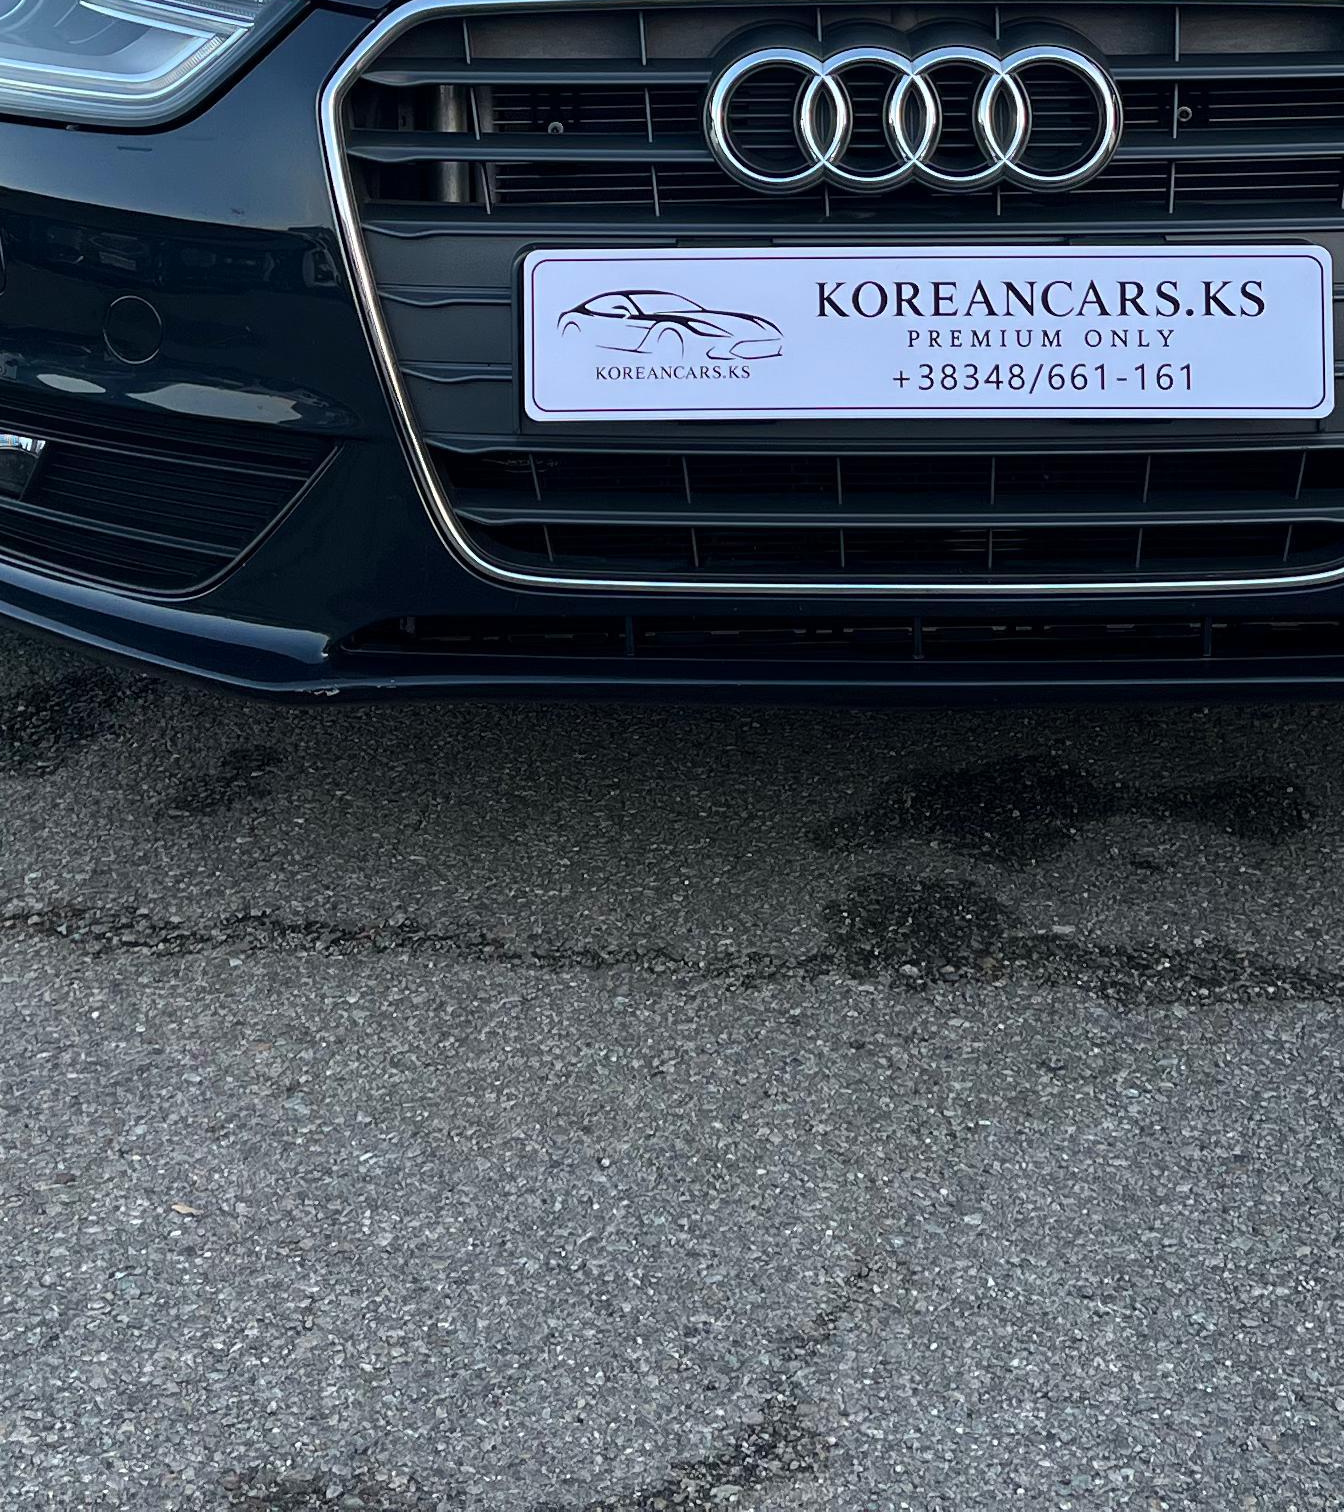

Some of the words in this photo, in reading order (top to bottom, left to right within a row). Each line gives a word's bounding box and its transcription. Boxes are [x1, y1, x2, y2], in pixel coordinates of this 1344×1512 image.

[815, 279, 1265, 318] KOREANCARS.KS
[907, 329, 1063, 348] PREMIUM
[1084, 329, 1175, 348] ONLY
[595, 365, 752, 381] KOREANCARS.KS
[892, 363, 1193, 395] +38348/661-161
